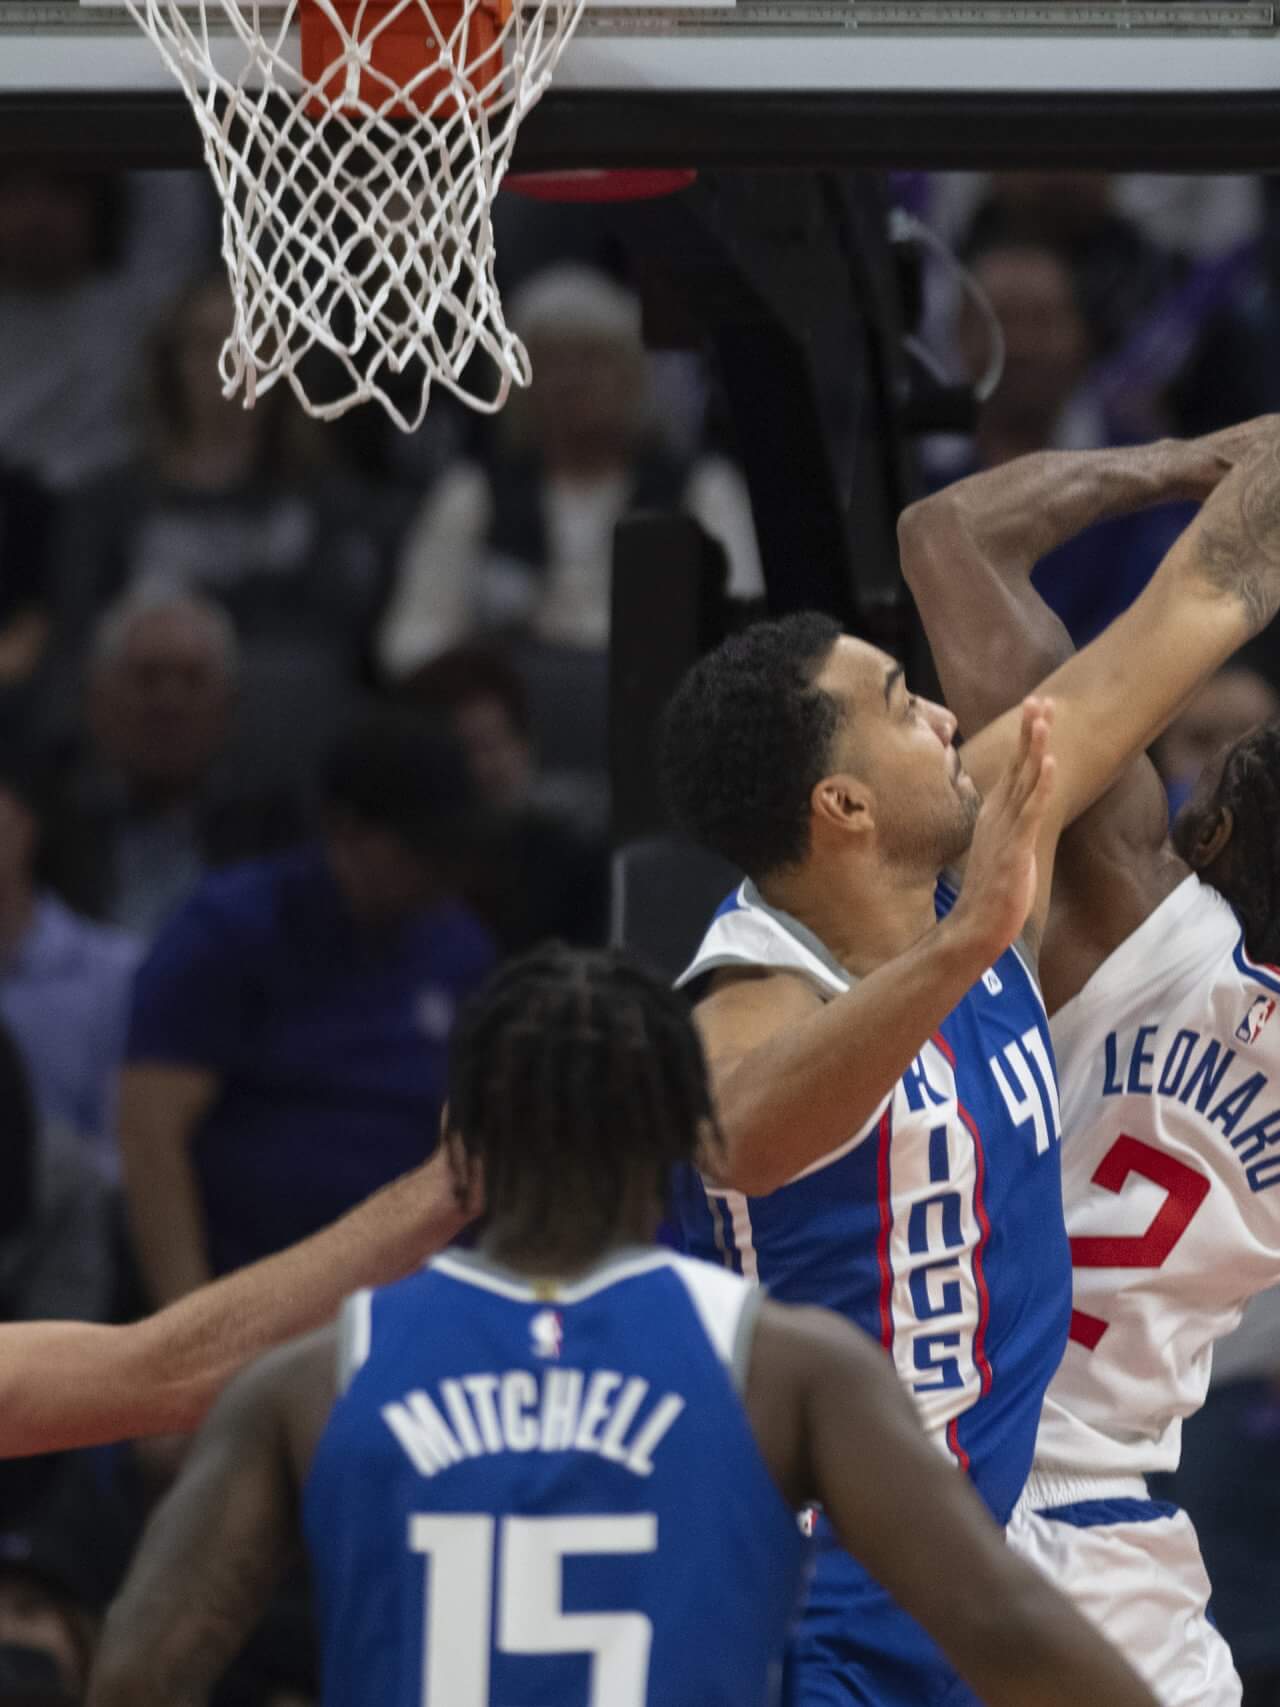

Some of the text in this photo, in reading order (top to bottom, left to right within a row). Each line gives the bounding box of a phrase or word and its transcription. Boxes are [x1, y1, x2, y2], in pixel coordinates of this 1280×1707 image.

[989, 1027, 1062, 1156] 41
[1069, 1134, 1211, 1351] 2
[380, 1367, 686, 1477] MITCHELL
[410, 1513, 658, 1707] 15
